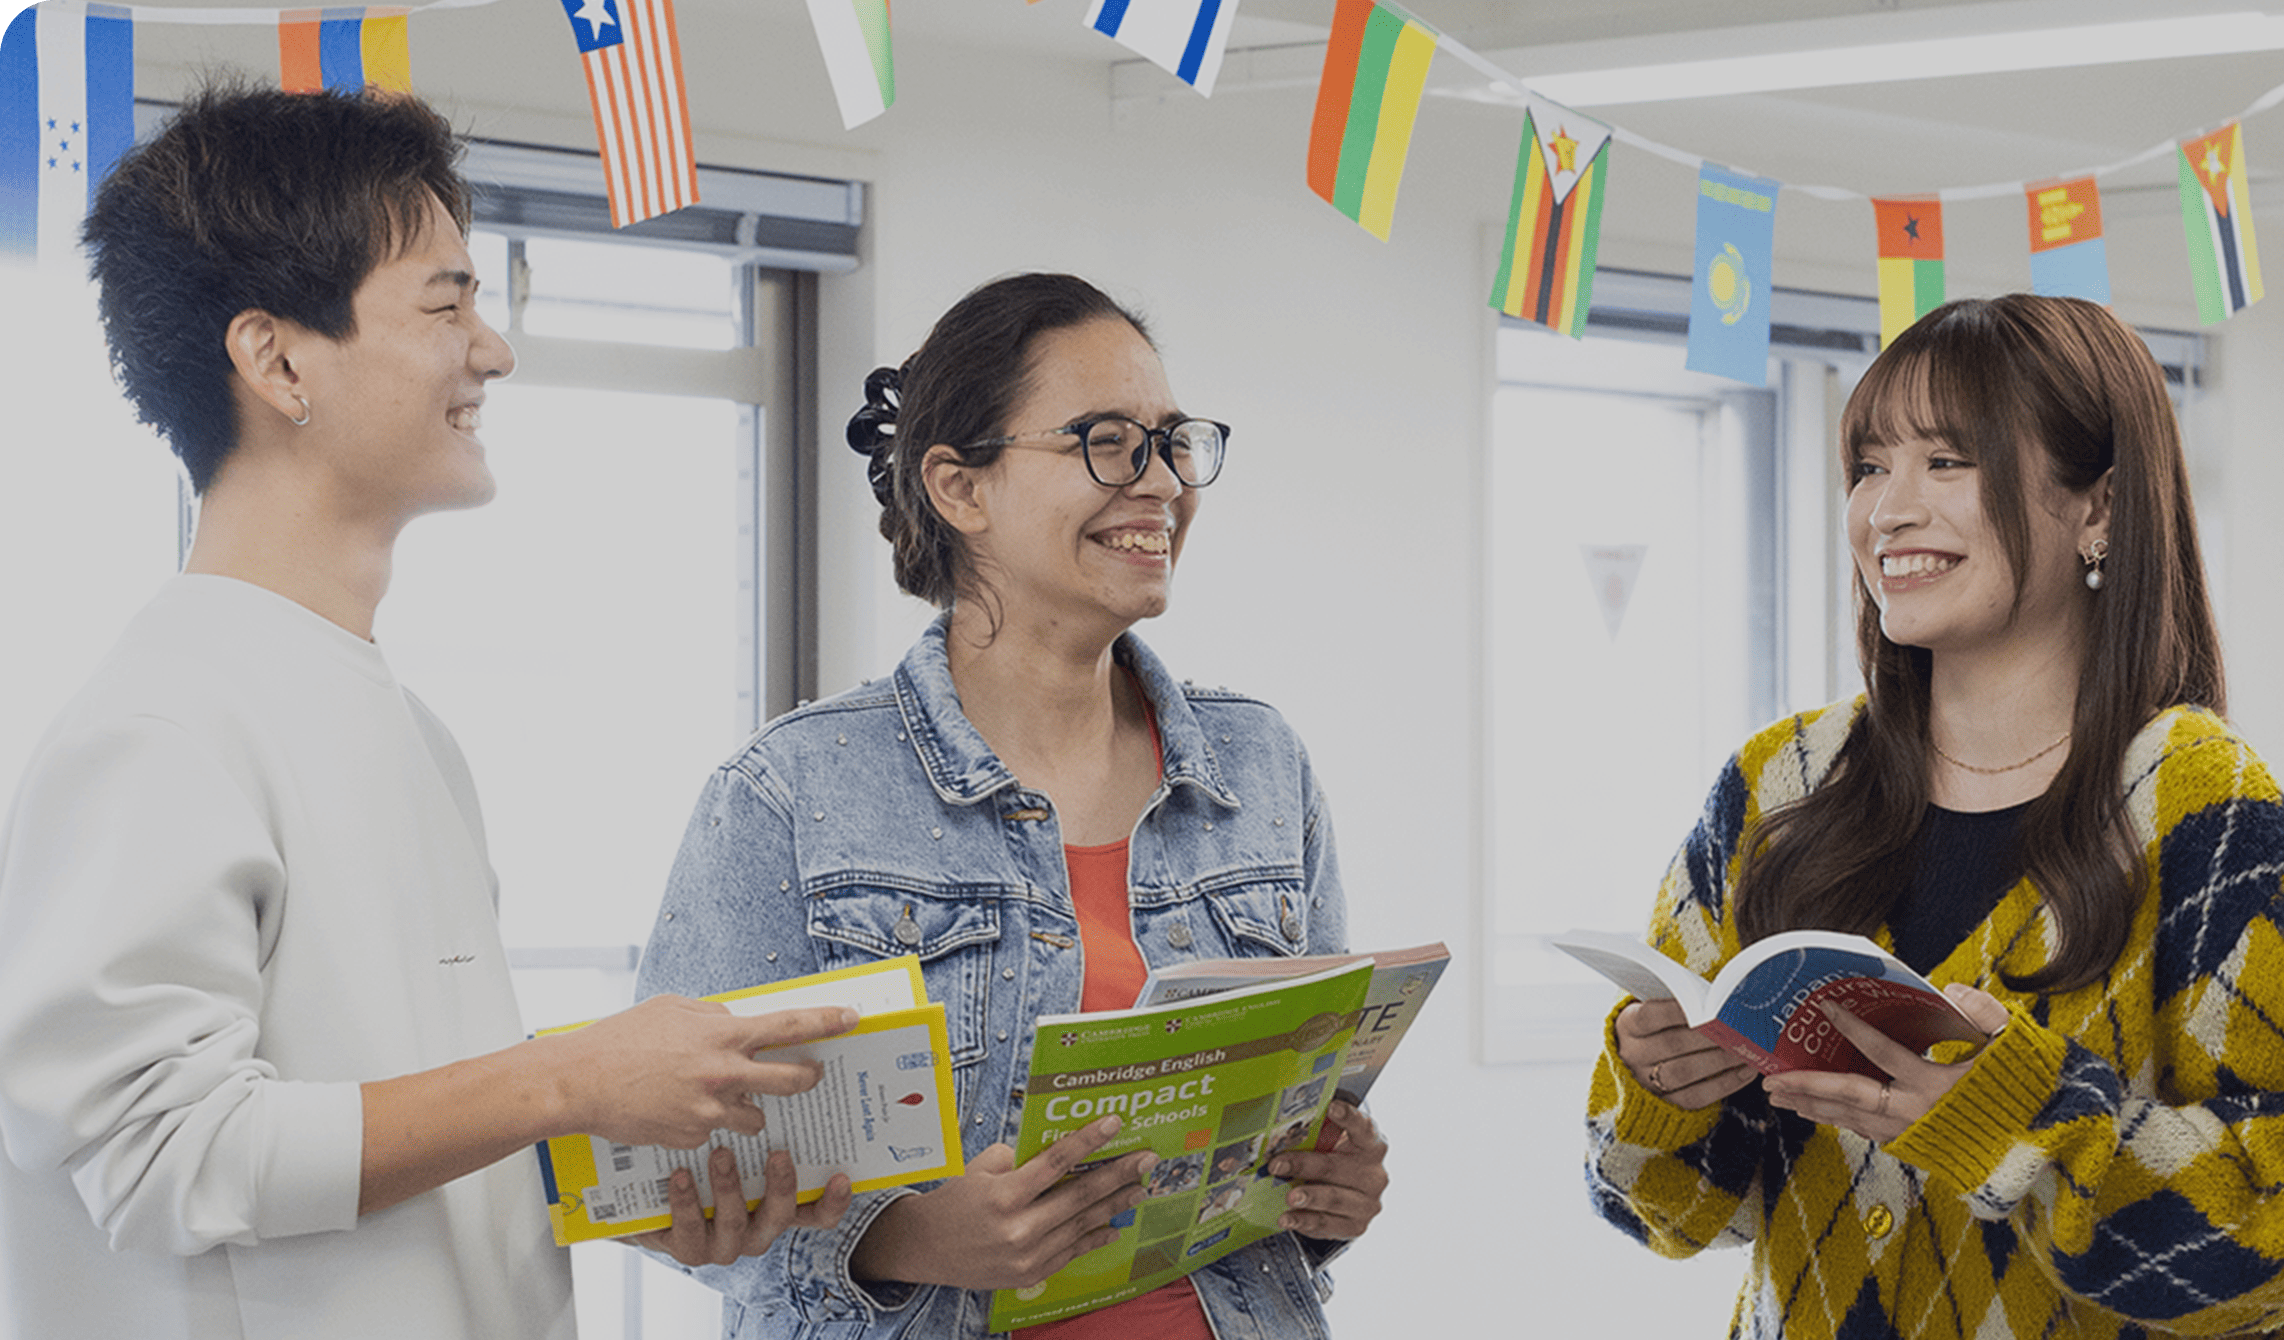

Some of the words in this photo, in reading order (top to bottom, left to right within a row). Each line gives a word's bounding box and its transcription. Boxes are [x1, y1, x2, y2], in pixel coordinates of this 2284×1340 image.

[1053, 1065, 1156, 1088] Cambridge
[1160, 1049, 1226, 1074] English
[1045, 1073, 1216, 1121] Compact
[1041, 1127, 1073, 1144] Fir
[1130, 1103, 1209, 1131] Schools
